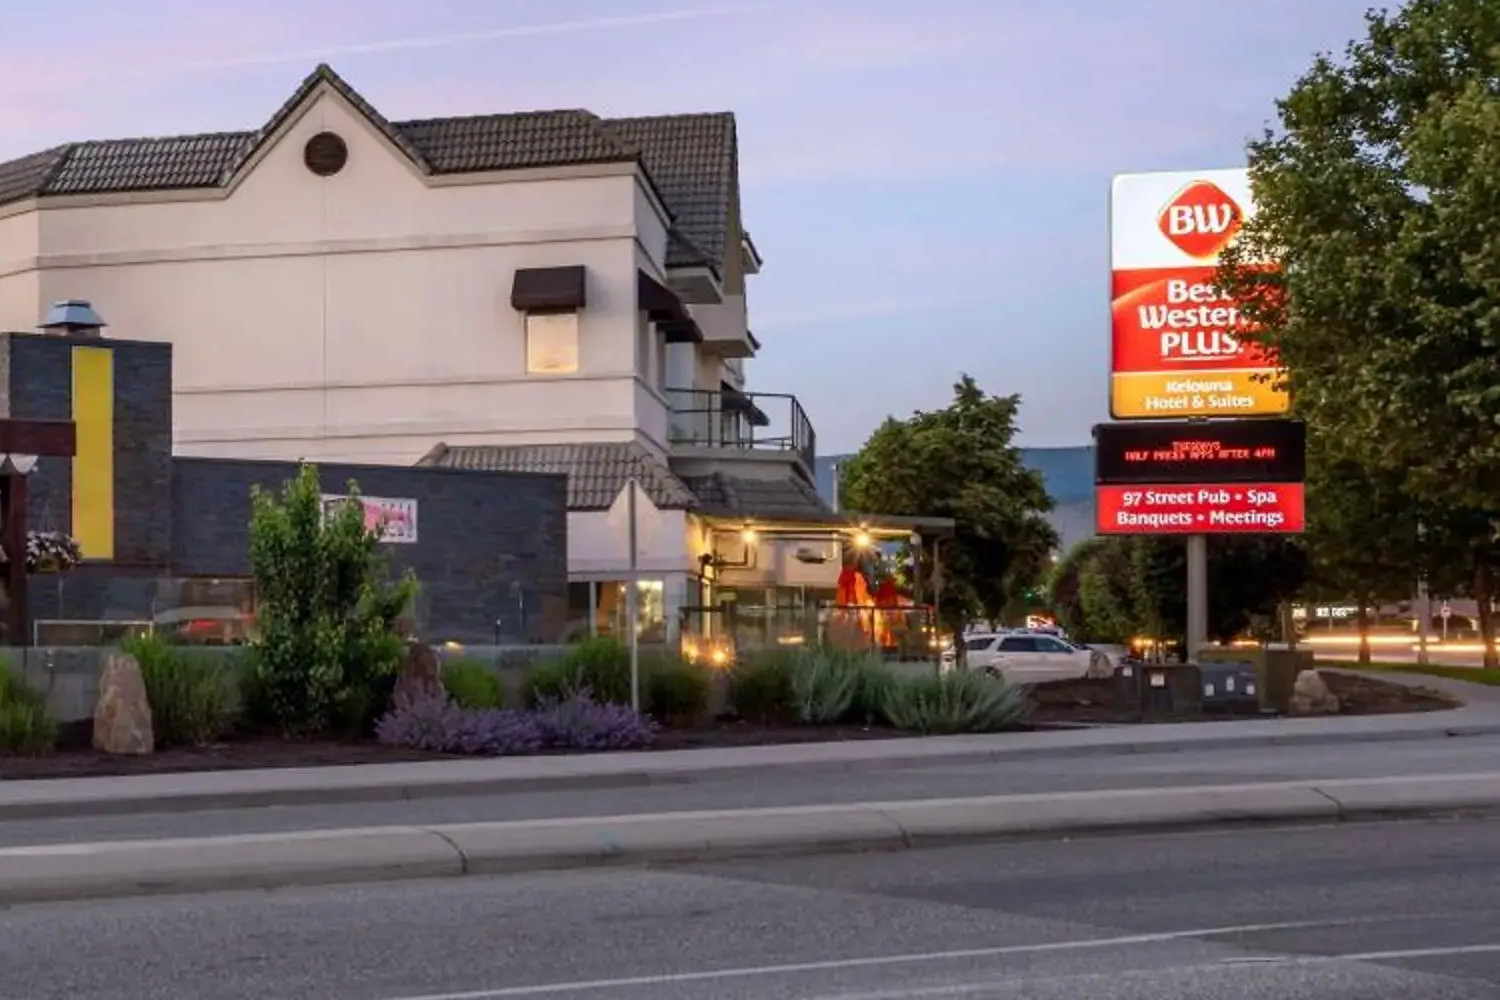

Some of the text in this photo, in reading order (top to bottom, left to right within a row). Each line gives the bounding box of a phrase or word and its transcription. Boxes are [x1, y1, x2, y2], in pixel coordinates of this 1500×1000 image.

[1168, 203, 1233, 236] BW
[1145, 394, 1254, 409] Hotel & Suites
[1123, 488, 1277, 506] 97 Street Pub Spa
[1116, 509, 1284, 528] Banquets Meetings
